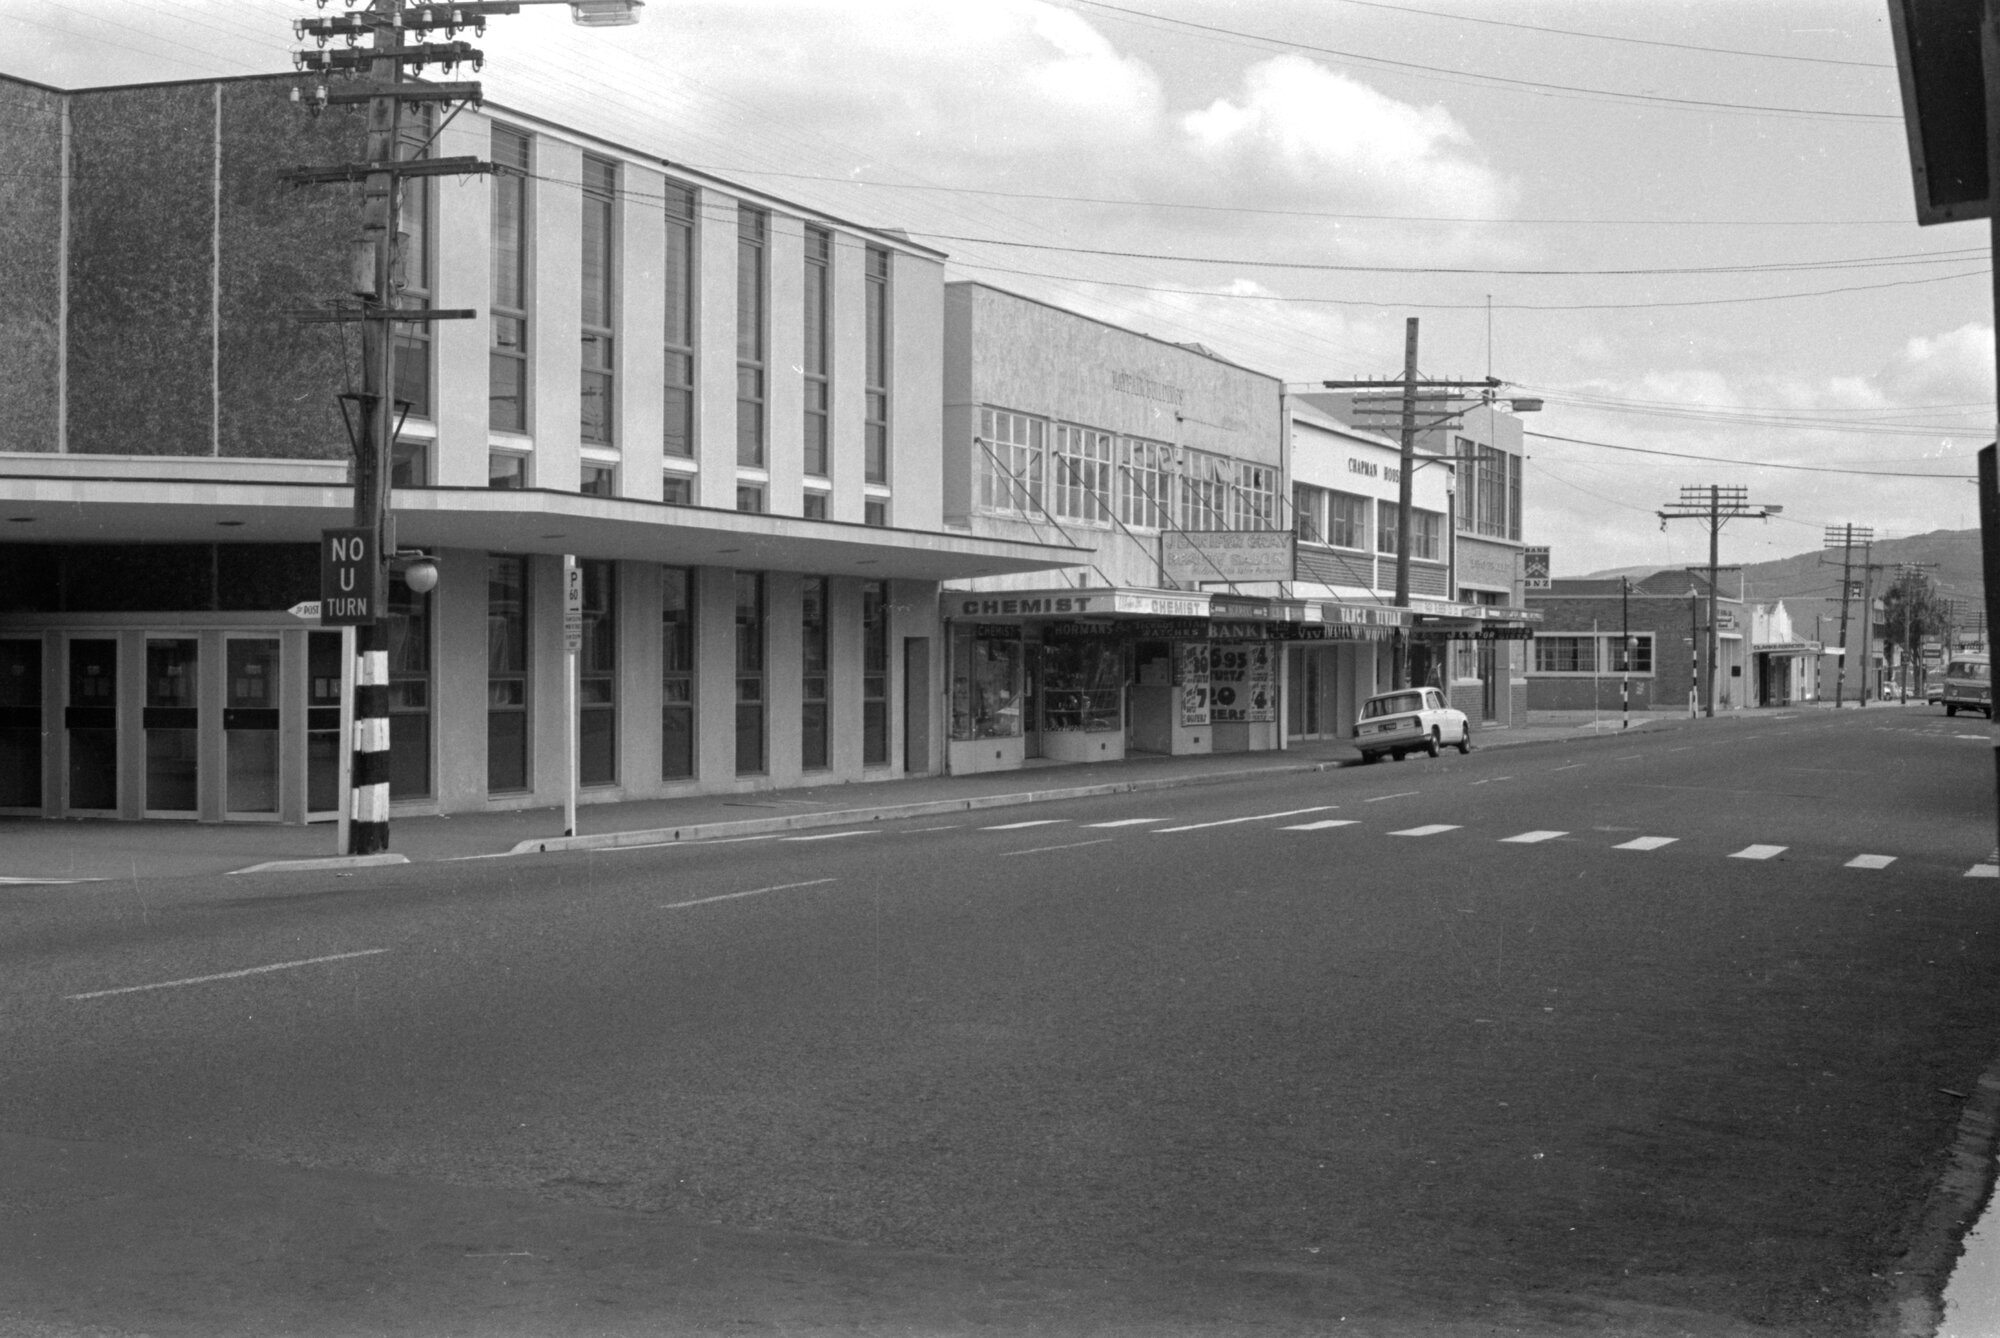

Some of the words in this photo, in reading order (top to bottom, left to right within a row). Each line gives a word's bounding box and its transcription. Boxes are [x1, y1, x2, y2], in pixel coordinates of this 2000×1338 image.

[1348, 457, 1378, 477] CHAPMAN
[1383, 466, 1400, 483] HOUS
[331, 537, 365, 562] NO
[340, 567, 355, 591] U
[570, 571, 578, 588] P
[569, 588, 579, 600] 60
[327, 597, 368, 617] TURN
[962, 597, 1092, 615] CHEMIST
[1151, 599, 1201, 617] CHEMIST
[978, 625, 1014, 637] CHEMIST
[1208, 622, 1257, 638] BANK
